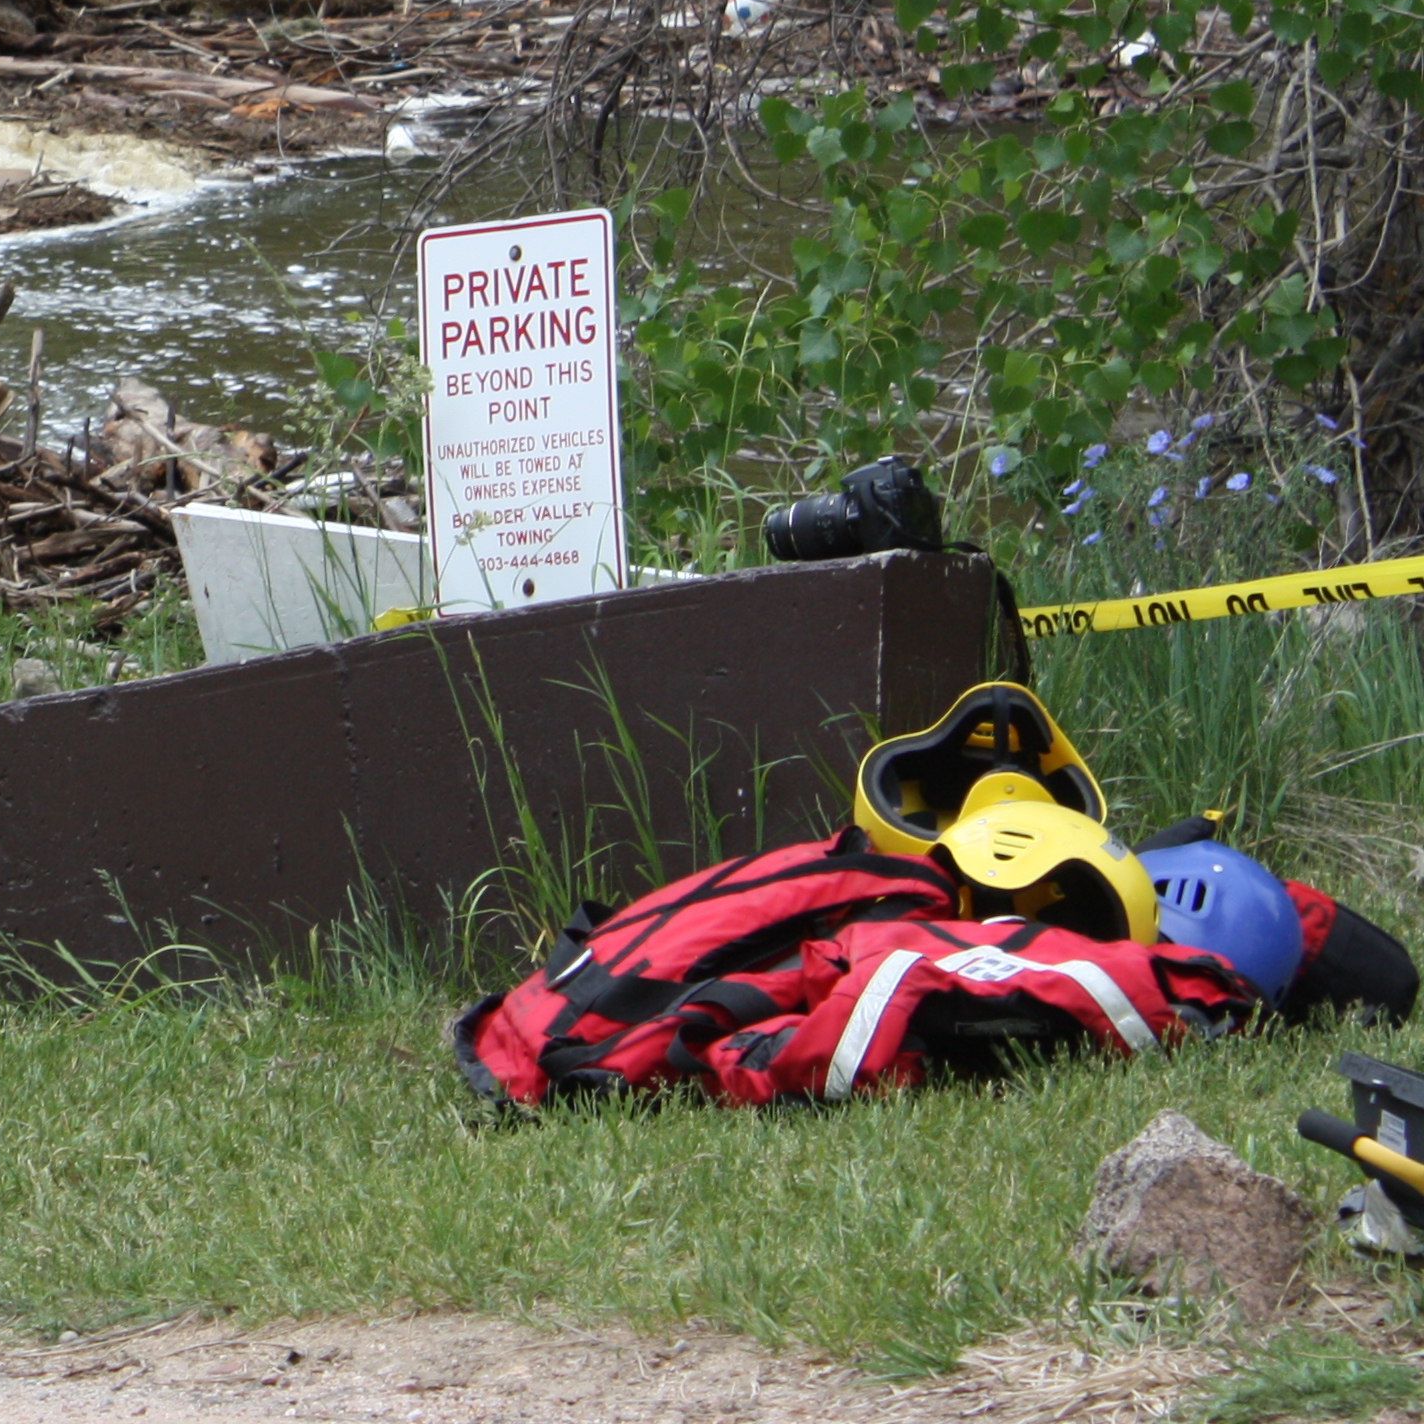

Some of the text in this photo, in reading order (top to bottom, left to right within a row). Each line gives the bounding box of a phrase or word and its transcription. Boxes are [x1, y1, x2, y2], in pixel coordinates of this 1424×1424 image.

[443, 258, 590, 312] PRIVATE
[441, 306, 597, 360] PARKING
[446, 360, 593, 397] BEYOND THIS
[488, 396, 551, 424] POINT
[437, 429, 605, 460] UNAUTHORIZED VEHICLES
[460, 453, 584, 480] WILL BE TOWED AT
[464, 475, 582, 501] OWNERS EXPENSE
[452, 501, 594, 529] BODER VALLEY
[496, 528, 554, 547] TOWING
[478, 550, 580, 571] 303-444-4868
